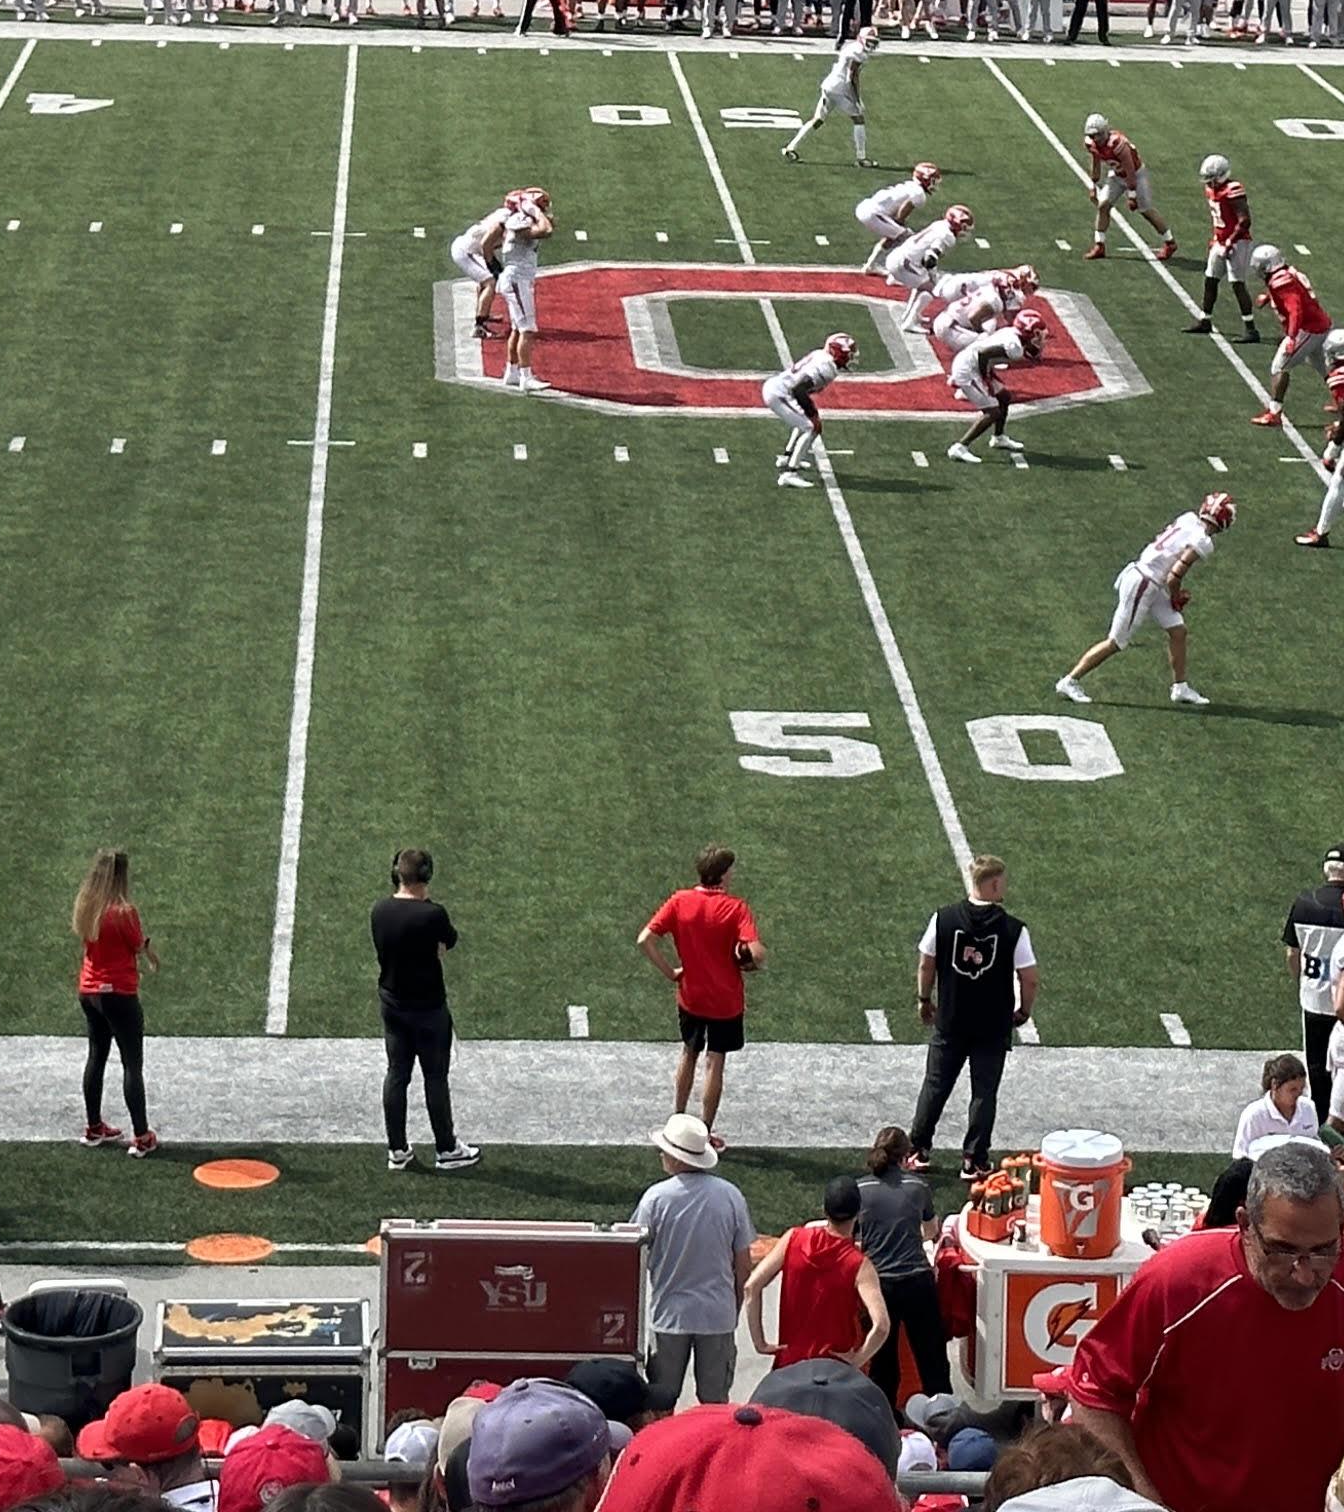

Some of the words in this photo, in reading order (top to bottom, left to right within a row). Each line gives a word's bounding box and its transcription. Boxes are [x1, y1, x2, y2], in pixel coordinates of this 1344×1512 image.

[1069, 1183, 1095, 1211] G
[479, 1280, 548, 1307] YSU
[1022, 1282, 1098, 1366] G
